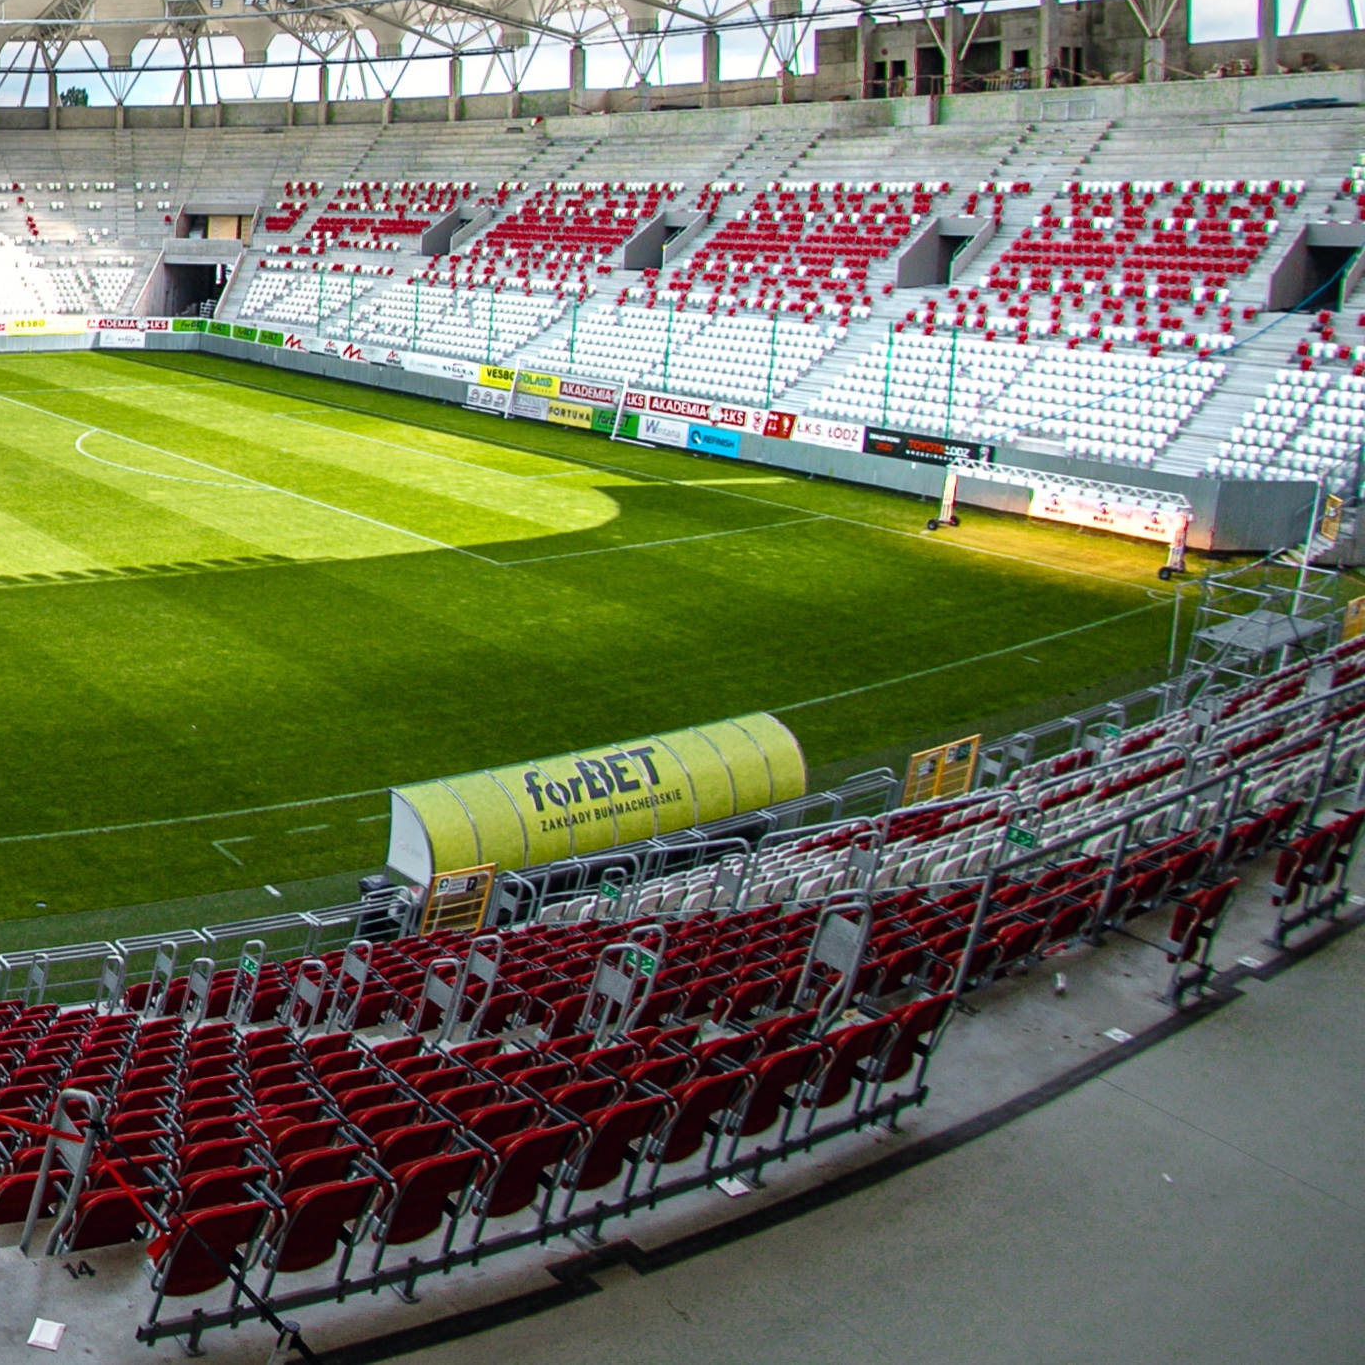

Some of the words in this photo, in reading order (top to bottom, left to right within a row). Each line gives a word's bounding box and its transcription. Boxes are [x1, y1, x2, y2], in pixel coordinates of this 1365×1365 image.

[15, 319, 45, 327] VESBO
[561, 383, 613, 401] AKADEMIA
[549, 406, 592, 422] FORTUNA
[651, 397, 707, 418] AKADEMIA
[723, 409, 745, 424] ŁKS
[703, 435, 735, 449] REFINISH
[828, 424, 859, 443] ŁÓDŹ
[908, 439, 945, 454] TOYOTA
[522, 745, 661, 812] forBET
[540, 810, 593, 834] ZAKŁADY
[594, 788, 683, 822] BUKMACHERSKIE
[61, 1259, 97, 1280] 14
